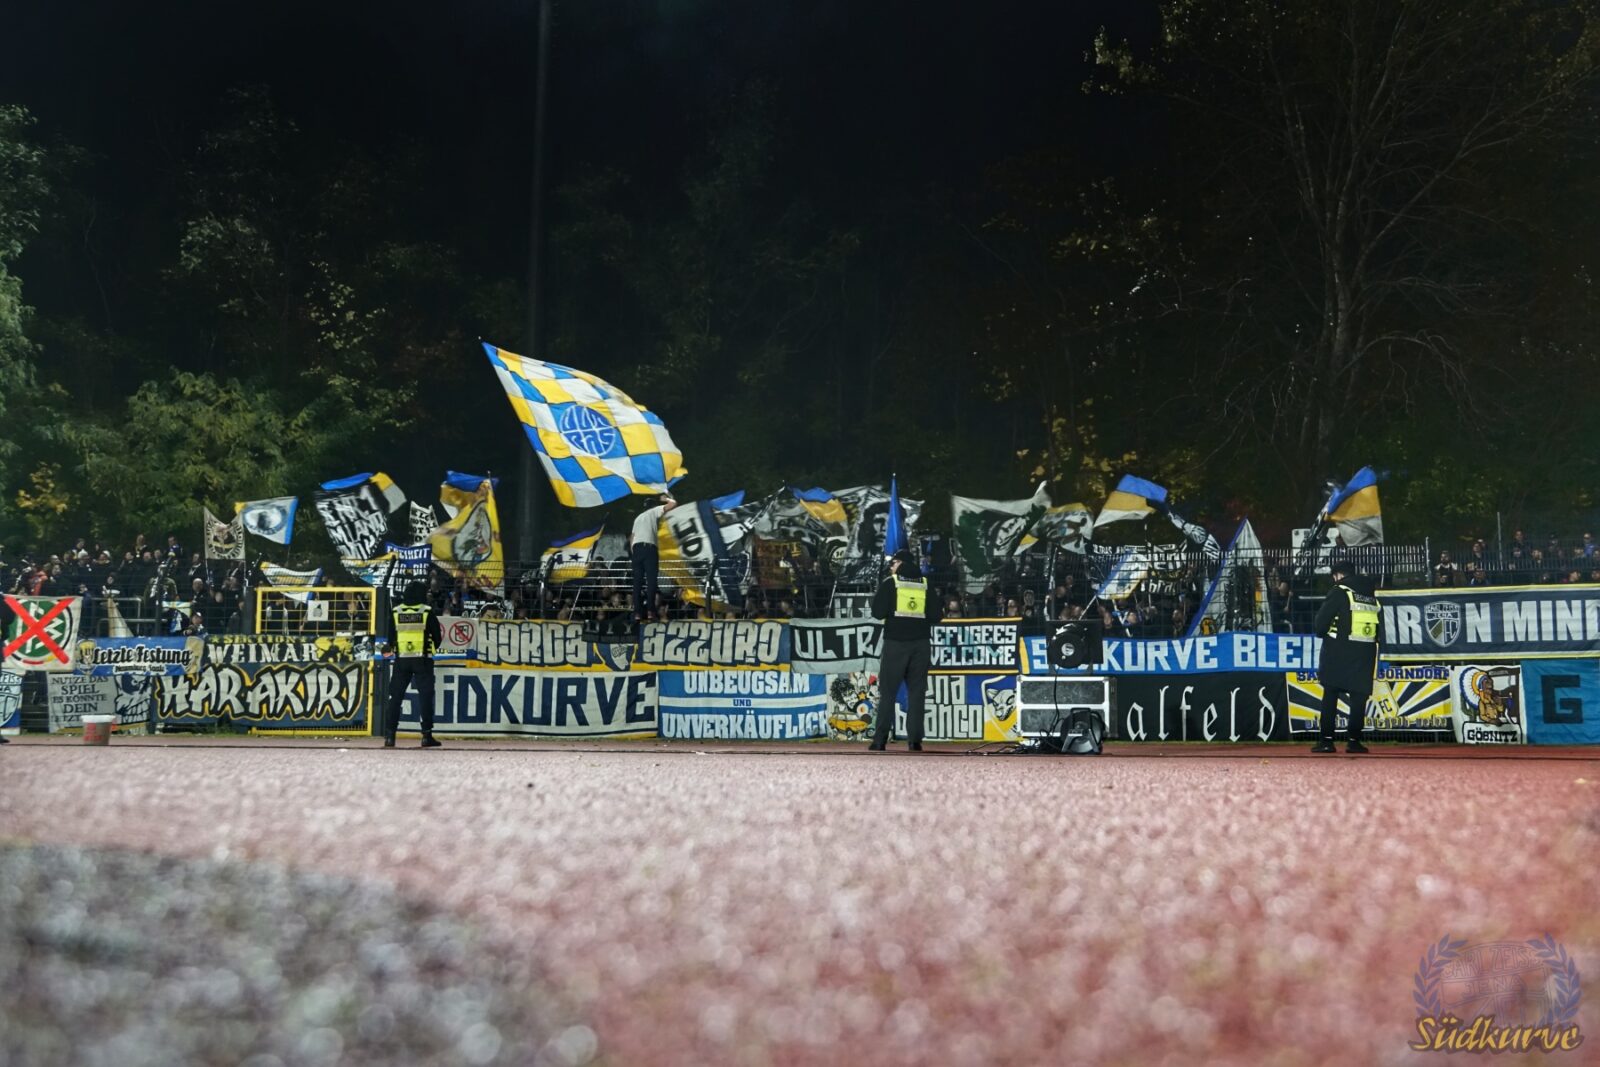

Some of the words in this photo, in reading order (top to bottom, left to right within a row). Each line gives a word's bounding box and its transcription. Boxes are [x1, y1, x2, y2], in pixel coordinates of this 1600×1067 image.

[208, 643, 319, 662] WEIMAR
[1030, 636, 1218, 671] SKURVE
[61, 684, 100, 695] SPIEL
[161, 666, 359, 716] HARAKIRI
[683, 669, 811, 695] UNBEUGSAM
[63, 703, 98, 714] DEIN
[732, 698, 752, 707] UND
[1541, 675, 1584, 724] G
